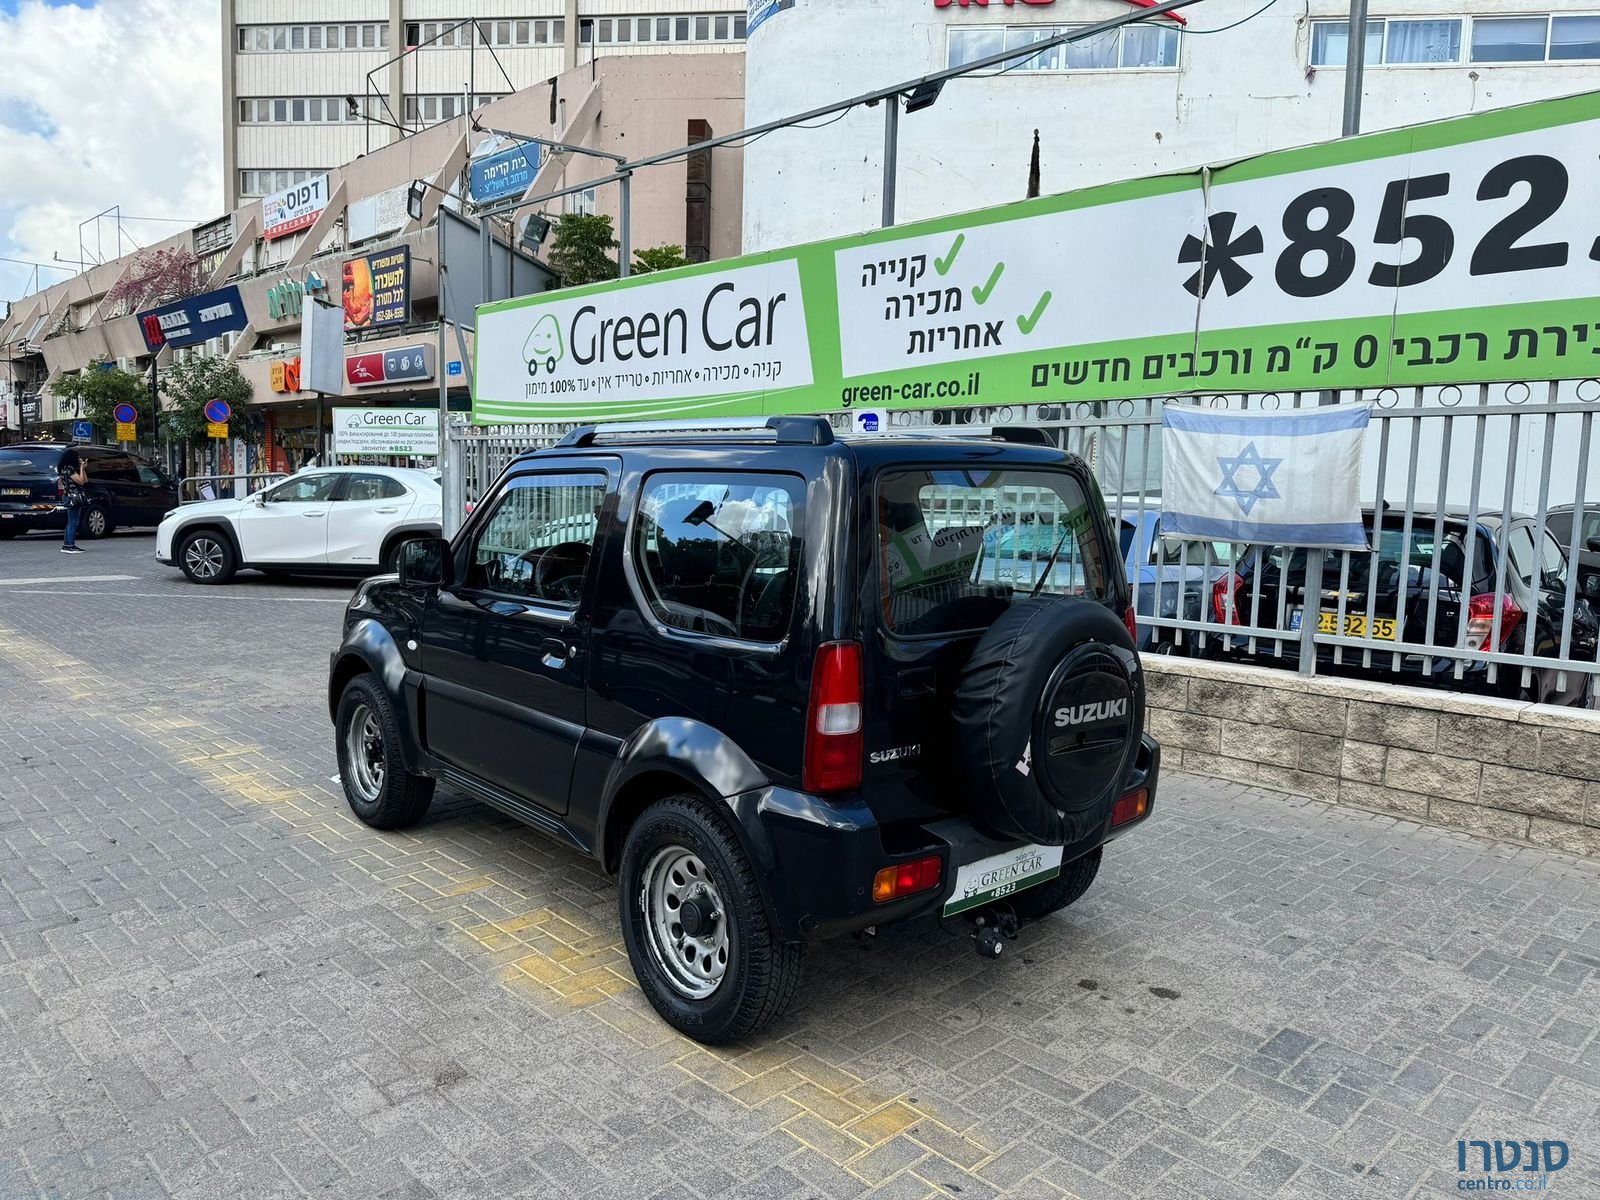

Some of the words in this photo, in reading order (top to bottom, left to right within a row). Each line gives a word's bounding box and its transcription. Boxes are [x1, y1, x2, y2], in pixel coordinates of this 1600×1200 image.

[484, 161, 509, 180] קדימה
[512, 156, 527, 171] בית
[286, 181, 320, 210] דפוס
[1176, 154, 1600, 300] 852
[374, 266, 404, 290] להשכרה
[861, 254, 927, 288] קנייה
[376, 292, 393, 307] מטרה
[392, 287, 404, 303] לכל
[884, 286, 962, 320] מכירה
[570, 305, 688, 366] Green
[701, 282, 786, 352] Car
[906, 320, 1004, 355] אחריות
[1392, 332, 1488, 366] רכבי
[1503, 323, 1600, 360] ירת
[1353, 333, 1378, 369] 0
[703, 364, 741, 382] מכירה
[752, 361, 782, 381] קניה
[1031, 357, 1131, 388] חדשים
[1142, 348, 1253, 380] ורכבים
[550, 379, 576, 393] 100%
[577, 378, 589, 391] עד
[597, 375, 612, 394] אין
[615, 373, 643, 388] טרייד
[651, 369, 692, 386] אחריות
[525, 381, 547, 399] מימון
[841, 372, 980, 408] green-car.co.il
[363, 411, 402, 425] Green
[404, 412, 427, 425] Car
[1054, 697, 1128, 727] SUZUKI
[869, 743, 921, 764] SUZUKI
[981, 864, 1019, 886] GREEN
[1021, 856, 1042, 873] CAR
